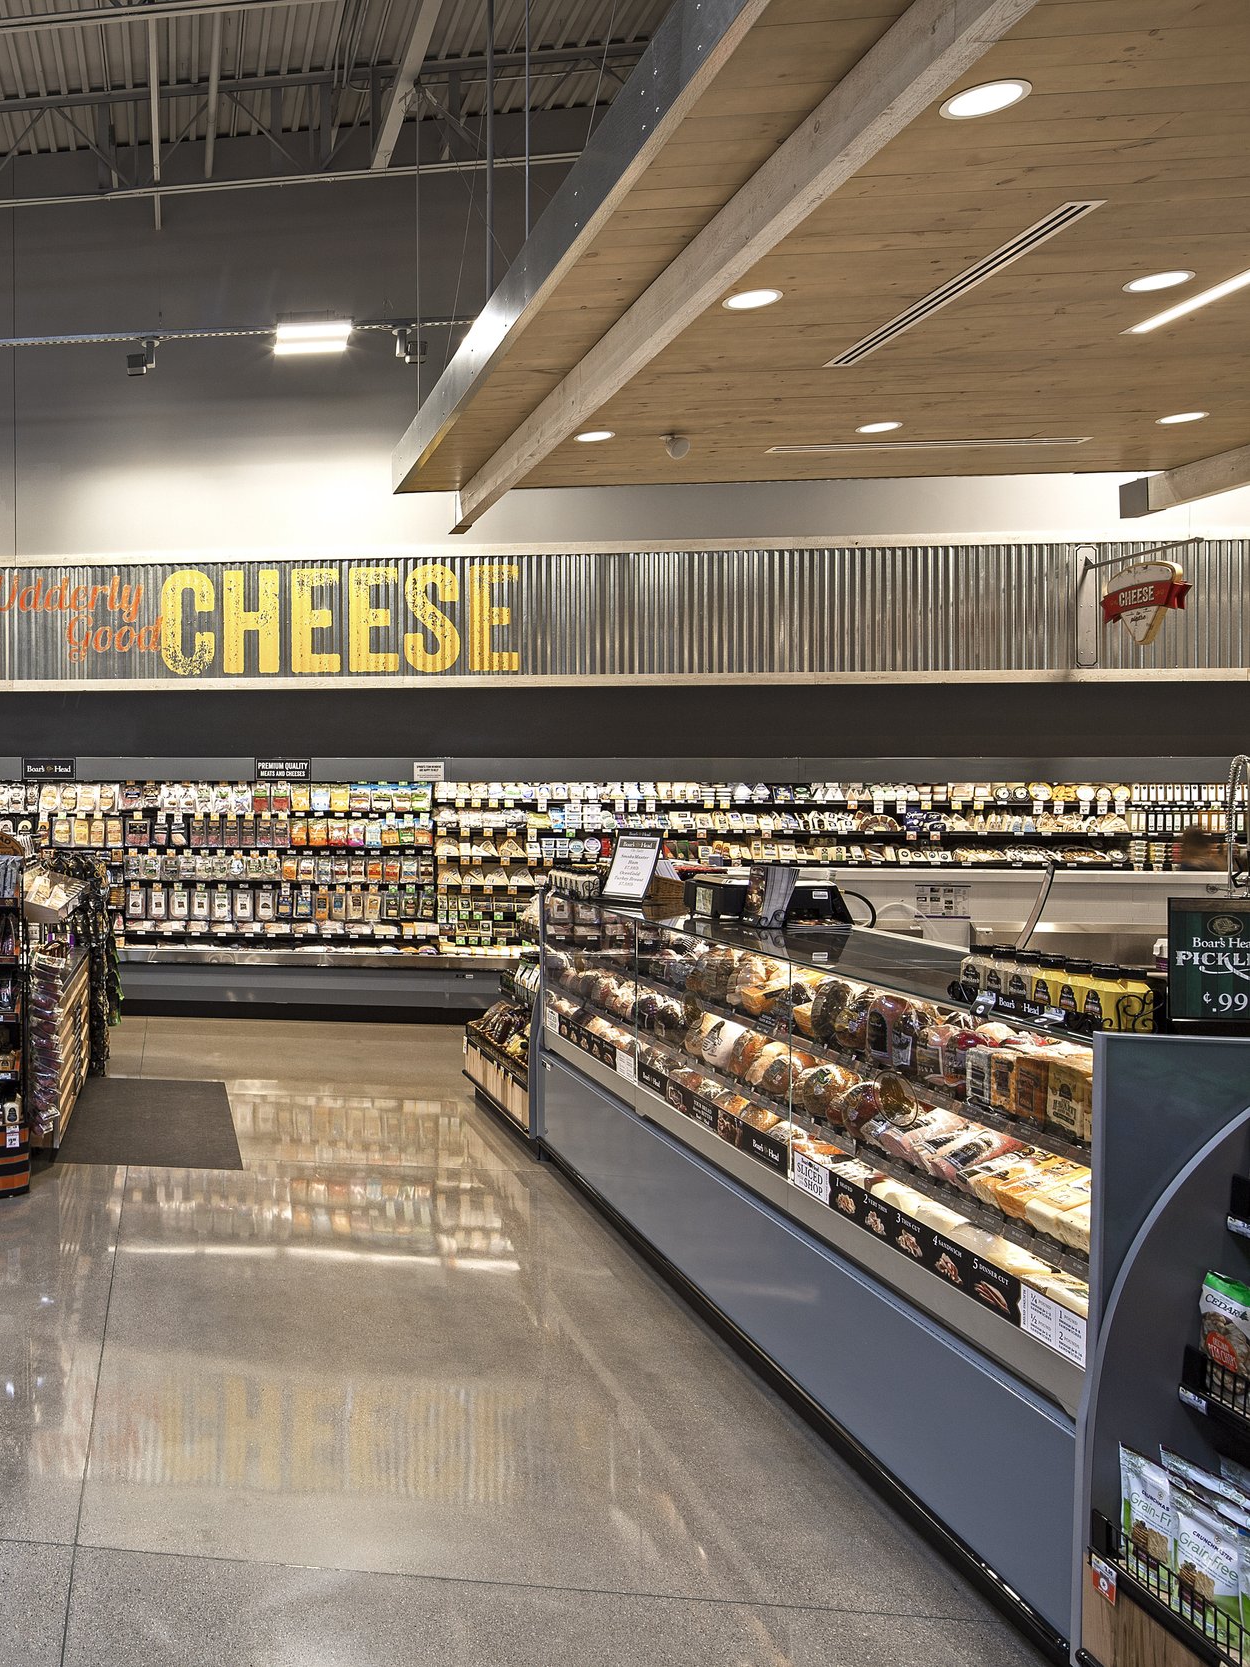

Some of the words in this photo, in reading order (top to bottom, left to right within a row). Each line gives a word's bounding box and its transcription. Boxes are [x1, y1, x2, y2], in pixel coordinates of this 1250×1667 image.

[1118, 585, 1155, 607] CHEESE
[161, 564, 519, 676] CHEESE
[66, 614, 163, 663] Good
[258, 762, 284, 770] PREMIUM
[285, 763, 308, 771] QUALITY
[1192, 936, 1226, 948] Boar's
[1229, 938, 1250, 948] Hea
[998, 997, 1016, 1009] Boar's
[1023, 1003, 1040, 1015] Head
[752, 1138, 764, 1152] Boar's
[768, 1148, 780, 1162] Head
[796, 1162, 823, 1185] SLICED
[836, 1177, 839, 1187] 1
[803, 1177, 823, 1196] SHOP
[863, 1193, 868, 1204] 2
[895, 1212, 901, 1224] 3
[901, 1217, 911, 1228] THIN
[911, 1224, 921, 1234] CUT
[932, 1235, 938, 1246] 4
[938, 1239, 962, 1258] SANDWICH
[972, 1258, 978, 1270] 5
[979, 1263, 997, 1280] DINNER
[998, 1275, 1009, 1286] CUT
[1059, 1310, 1063, 1319] 1
[1059, 1331, 1064, 1341] 2
[1130, 1491, 1171, 1527] Grain-Fr
[1141, 1489, 1170, 1512] CRUNCHMAS
[1179, 1532, 1239, 1580] Grain-Free
[1192, 1530, 1233, 1562] CRUNCHMASTER
